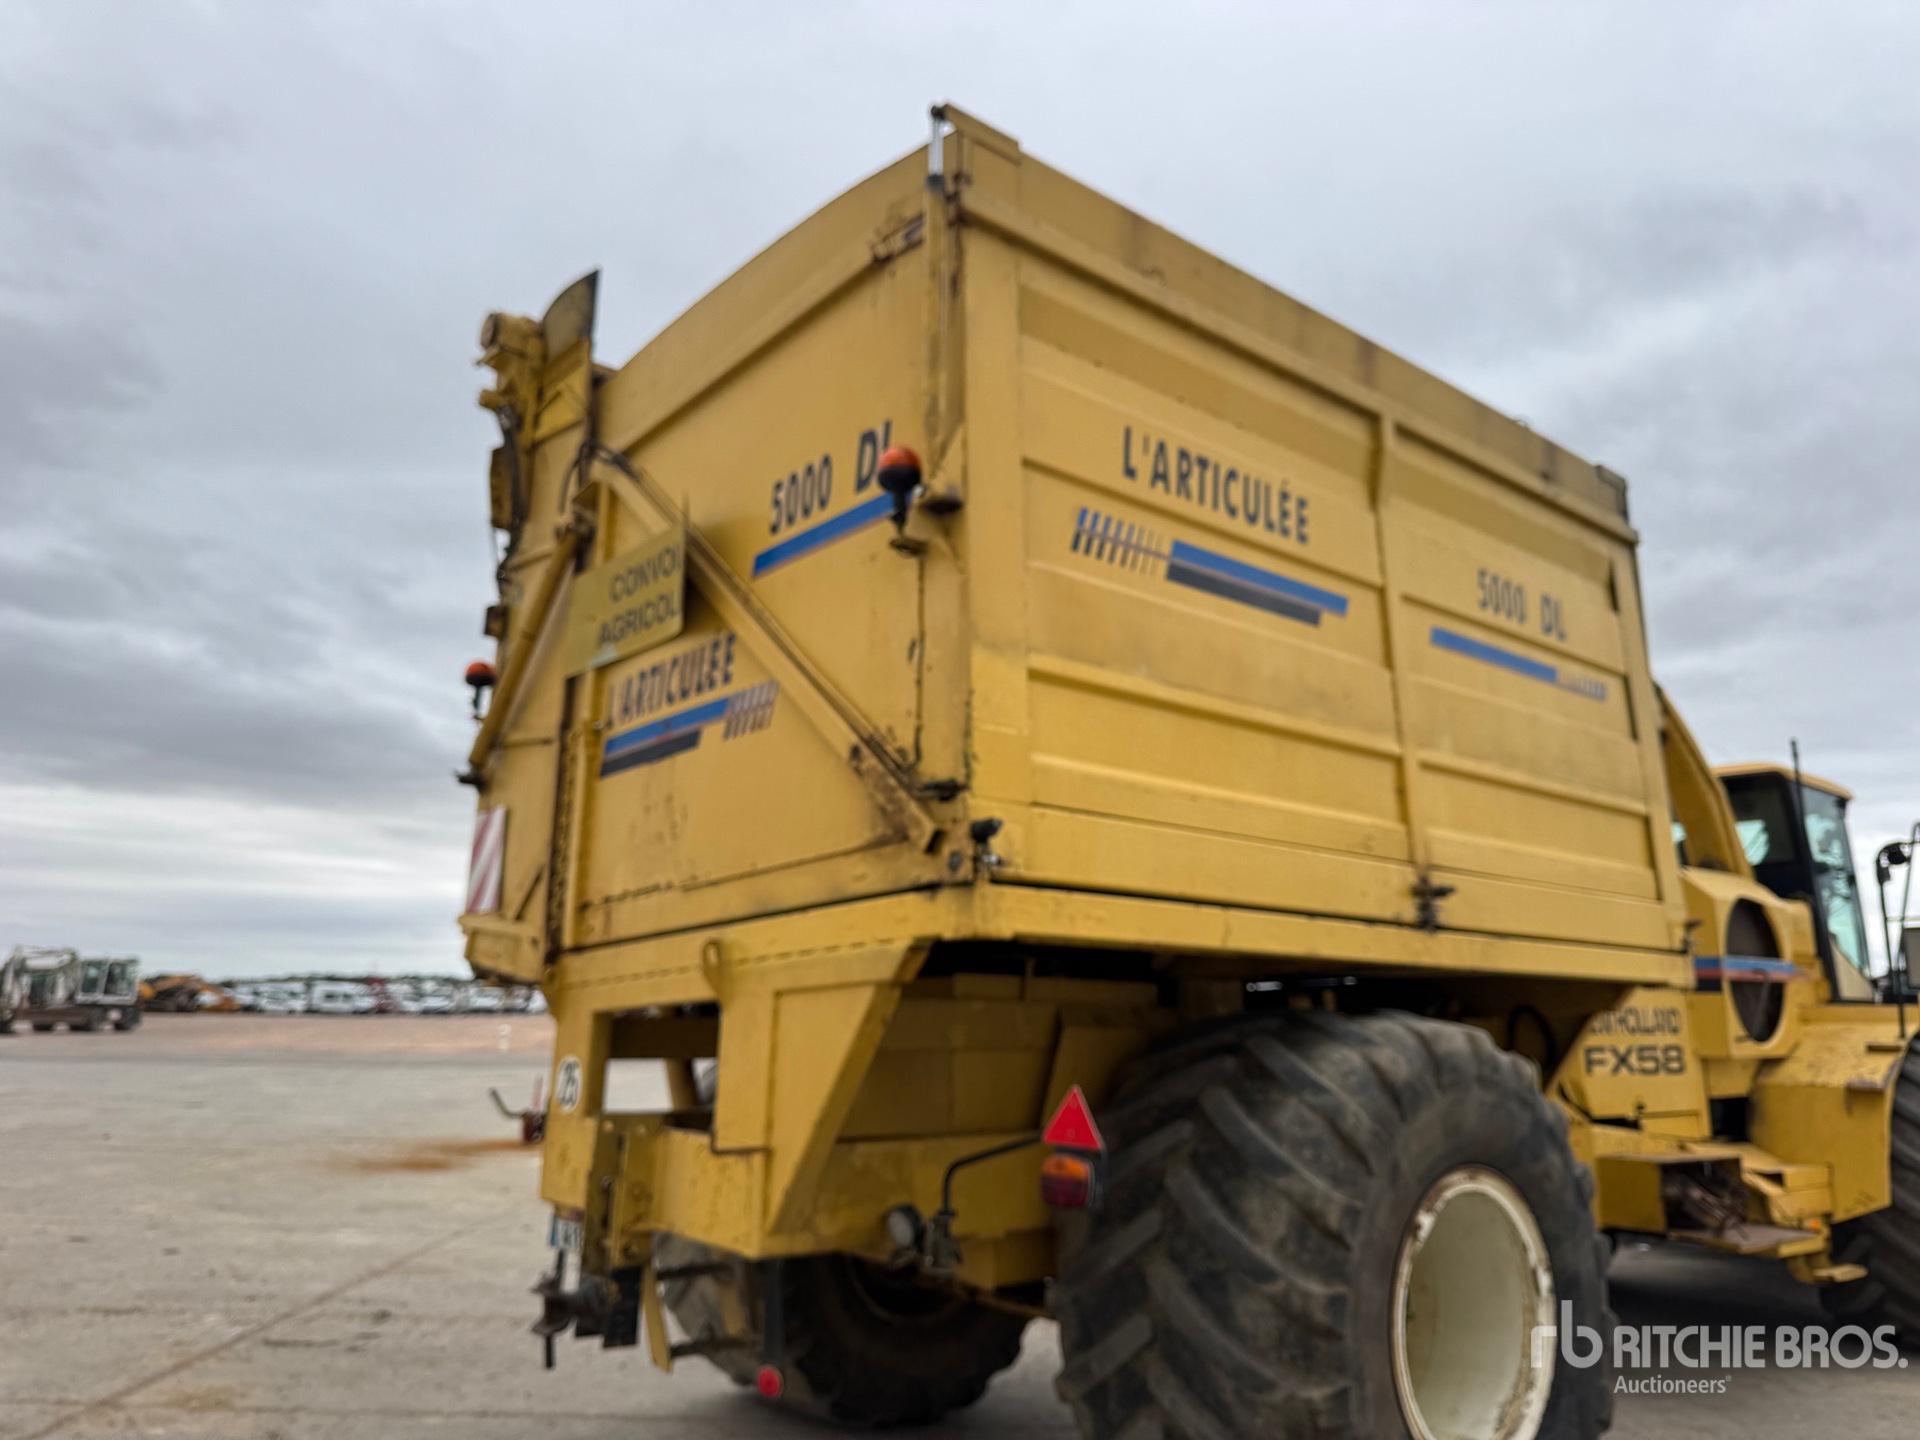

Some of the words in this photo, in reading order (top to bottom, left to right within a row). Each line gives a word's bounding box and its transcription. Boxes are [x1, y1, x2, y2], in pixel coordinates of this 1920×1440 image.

[769, 453, 833, 537] 5000
[1123, 425, 1309, 546] L'ARTICULÉE
[598, 591, 681, 645] AGRICOL
[1477, 567, 1526, 625] 5000
[1541, 592, 1567, 641] DL
[1585, 1044, 1686, 1076] FX58
